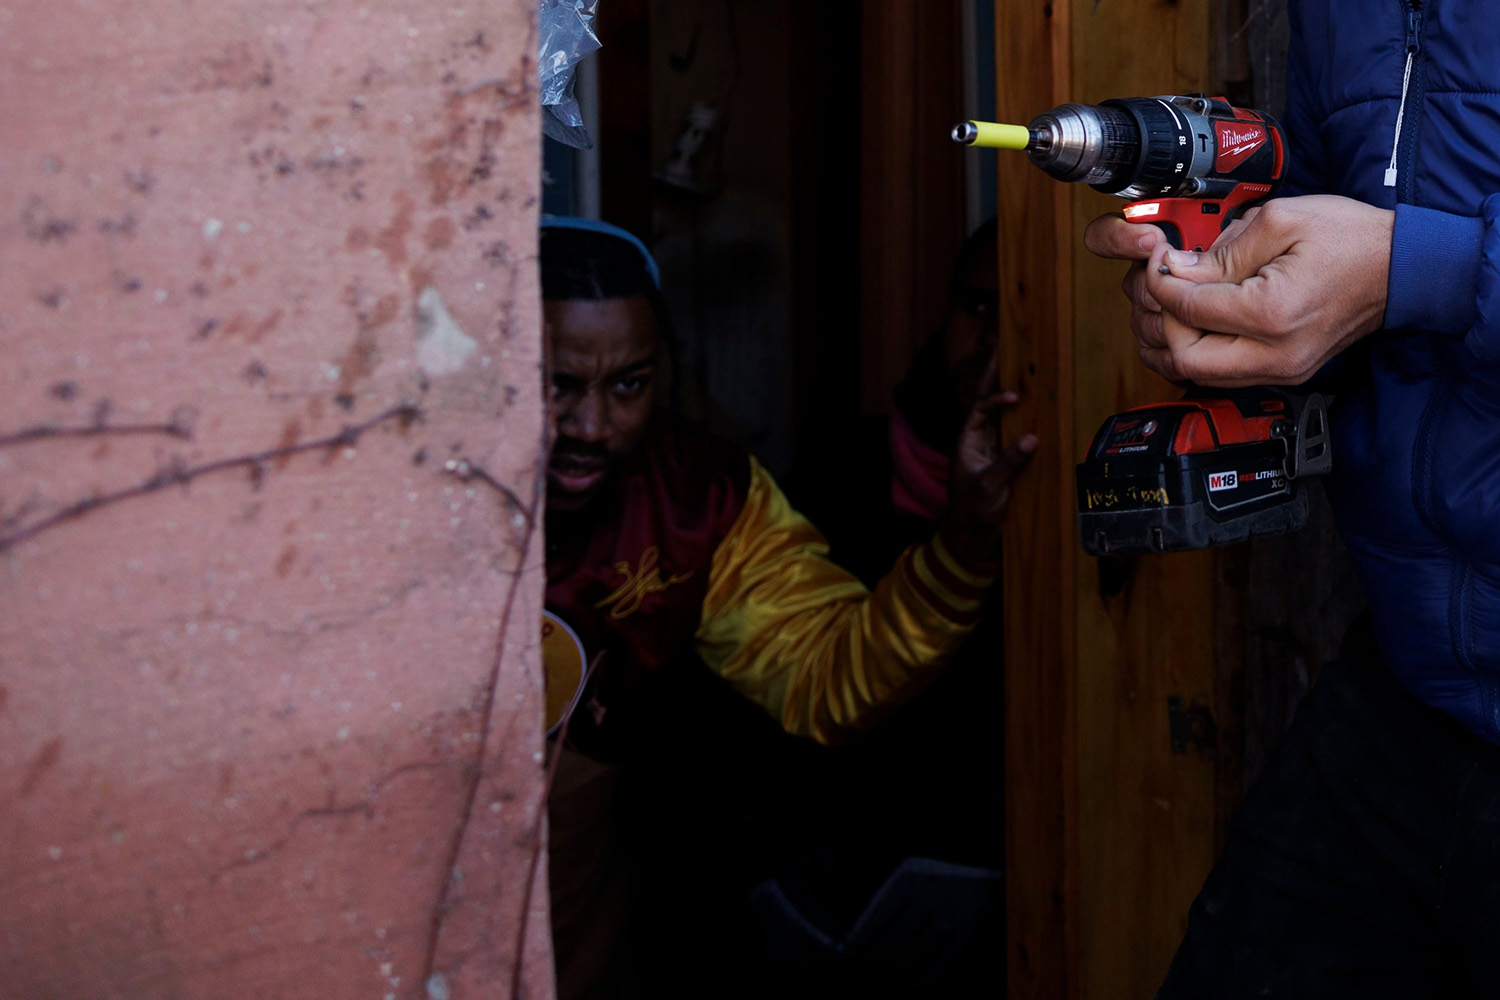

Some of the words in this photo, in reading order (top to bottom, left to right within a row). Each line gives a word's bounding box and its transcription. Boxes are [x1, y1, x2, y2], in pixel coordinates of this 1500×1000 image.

[1178, 135, 1187, 146] 18
[1174, 162, 1184, 173] 16
[1211, 474, 1236, 488] M18
[1271, 478, 1285, 489] XC
